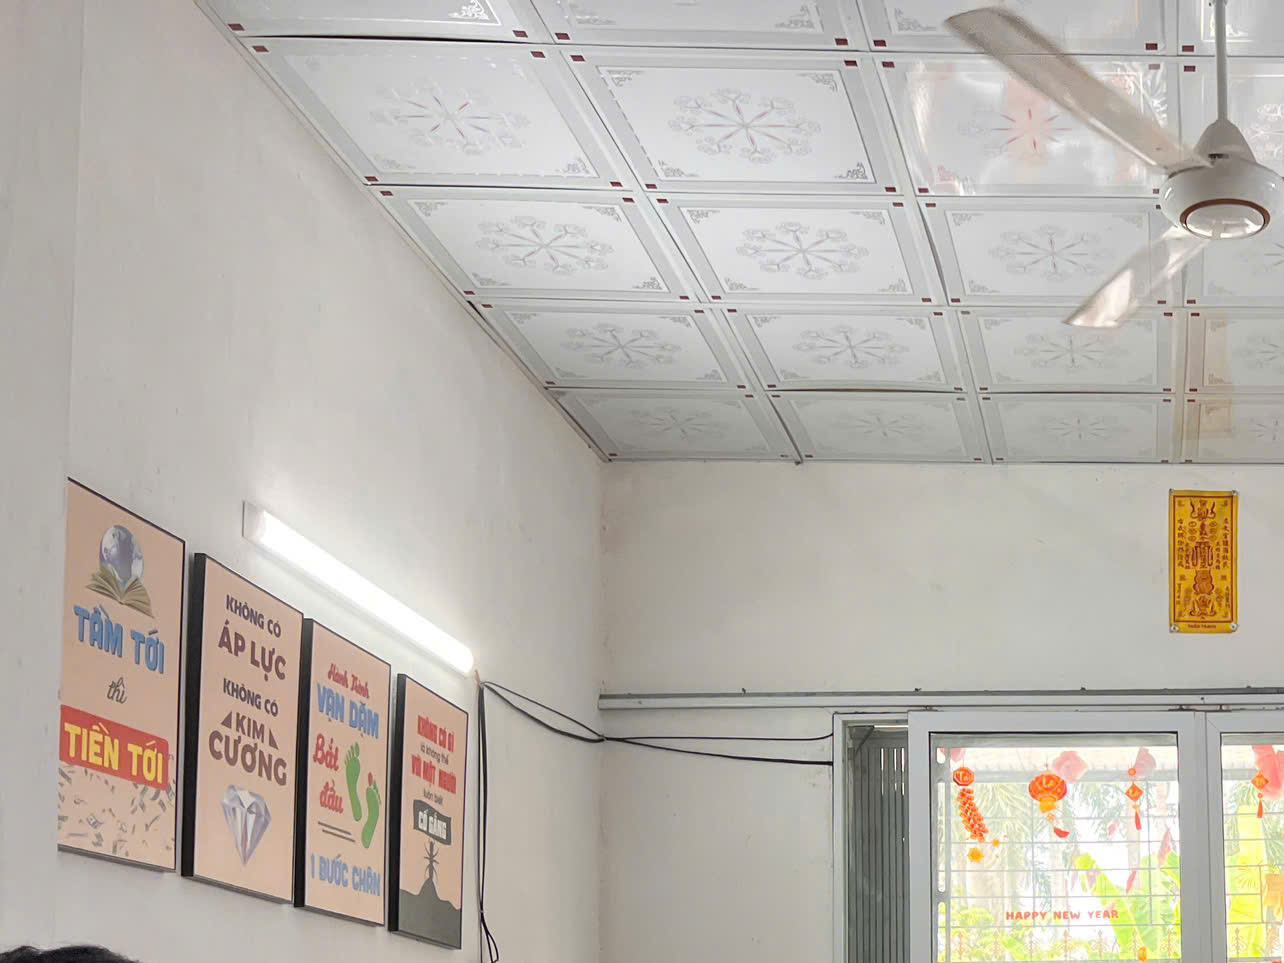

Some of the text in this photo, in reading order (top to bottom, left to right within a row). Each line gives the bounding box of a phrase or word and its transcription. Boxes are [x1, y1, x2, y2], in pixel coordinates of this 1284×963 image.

[226, 595, 281, 638] KHÔNG CÓ
[73, 604, 165, 674] TẦM TỚI
[218, 619, 286, 682] ÁP LỰC
[223, 678, 278, 717] KHÔNG CÓ
[317, 683, 379, 739] VẠN DẶM
[236, 712, 265, 743] KIM
[64, 722, 163, 784] TIỀN TỚI
[208, 730, 287, 786] CƯƠNG
[313, 733, 339, 771] Bắt
[320, 779, 344, 814] đầu
[310, 853, 381, 896] 1 BƯỚC CHÂN
[1006, 910, 1119, 920] HAPPY NEW YEAR
